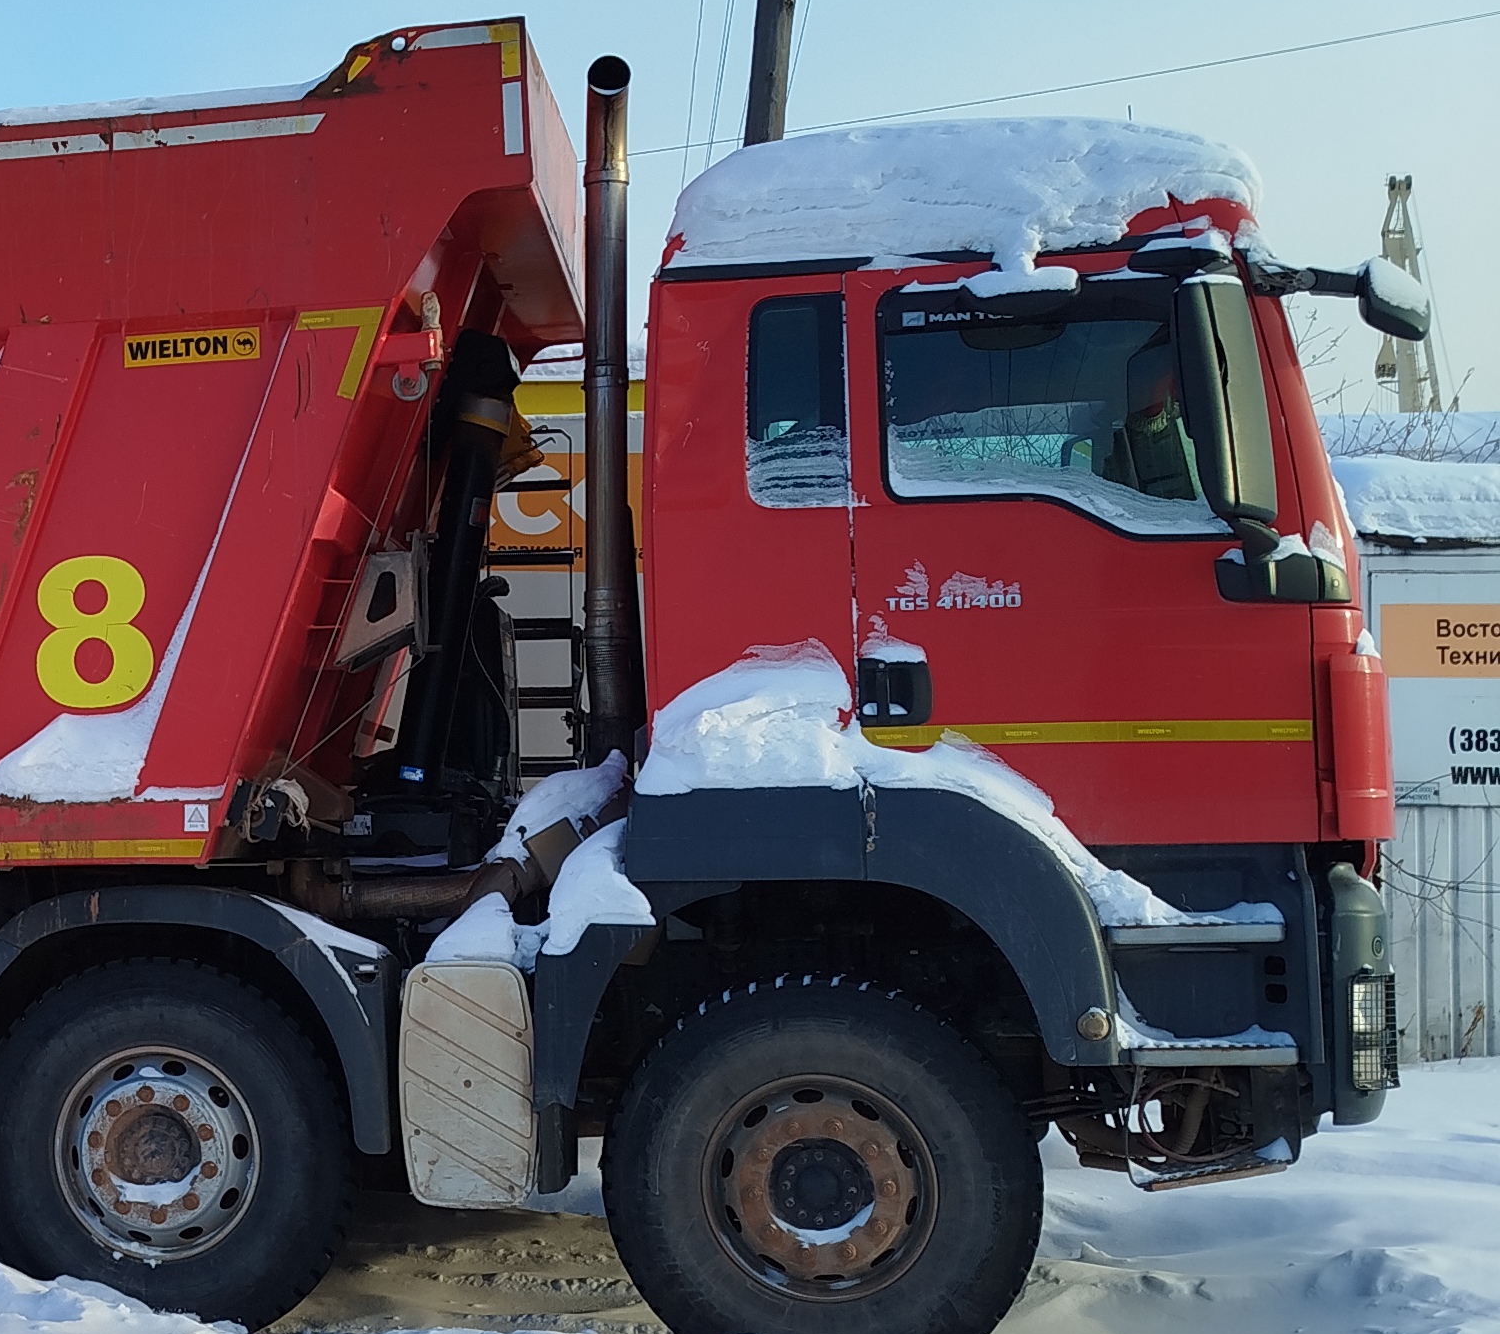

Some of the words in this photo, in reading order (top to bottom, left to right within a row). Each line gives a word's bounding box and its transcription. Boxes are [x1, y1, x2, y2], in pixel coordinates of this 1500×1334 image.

[928, 311, 971, 323] MAN
[128, 335, 228, 361] WIELTON
[885, 597, 929, 611] TGS
[36, 555, 154, 708] 8
[1436, 619, 1500, 638] Восто
[1436, 646, 1500, 665] Техни
[1449, 727, 1500, 754] (383
